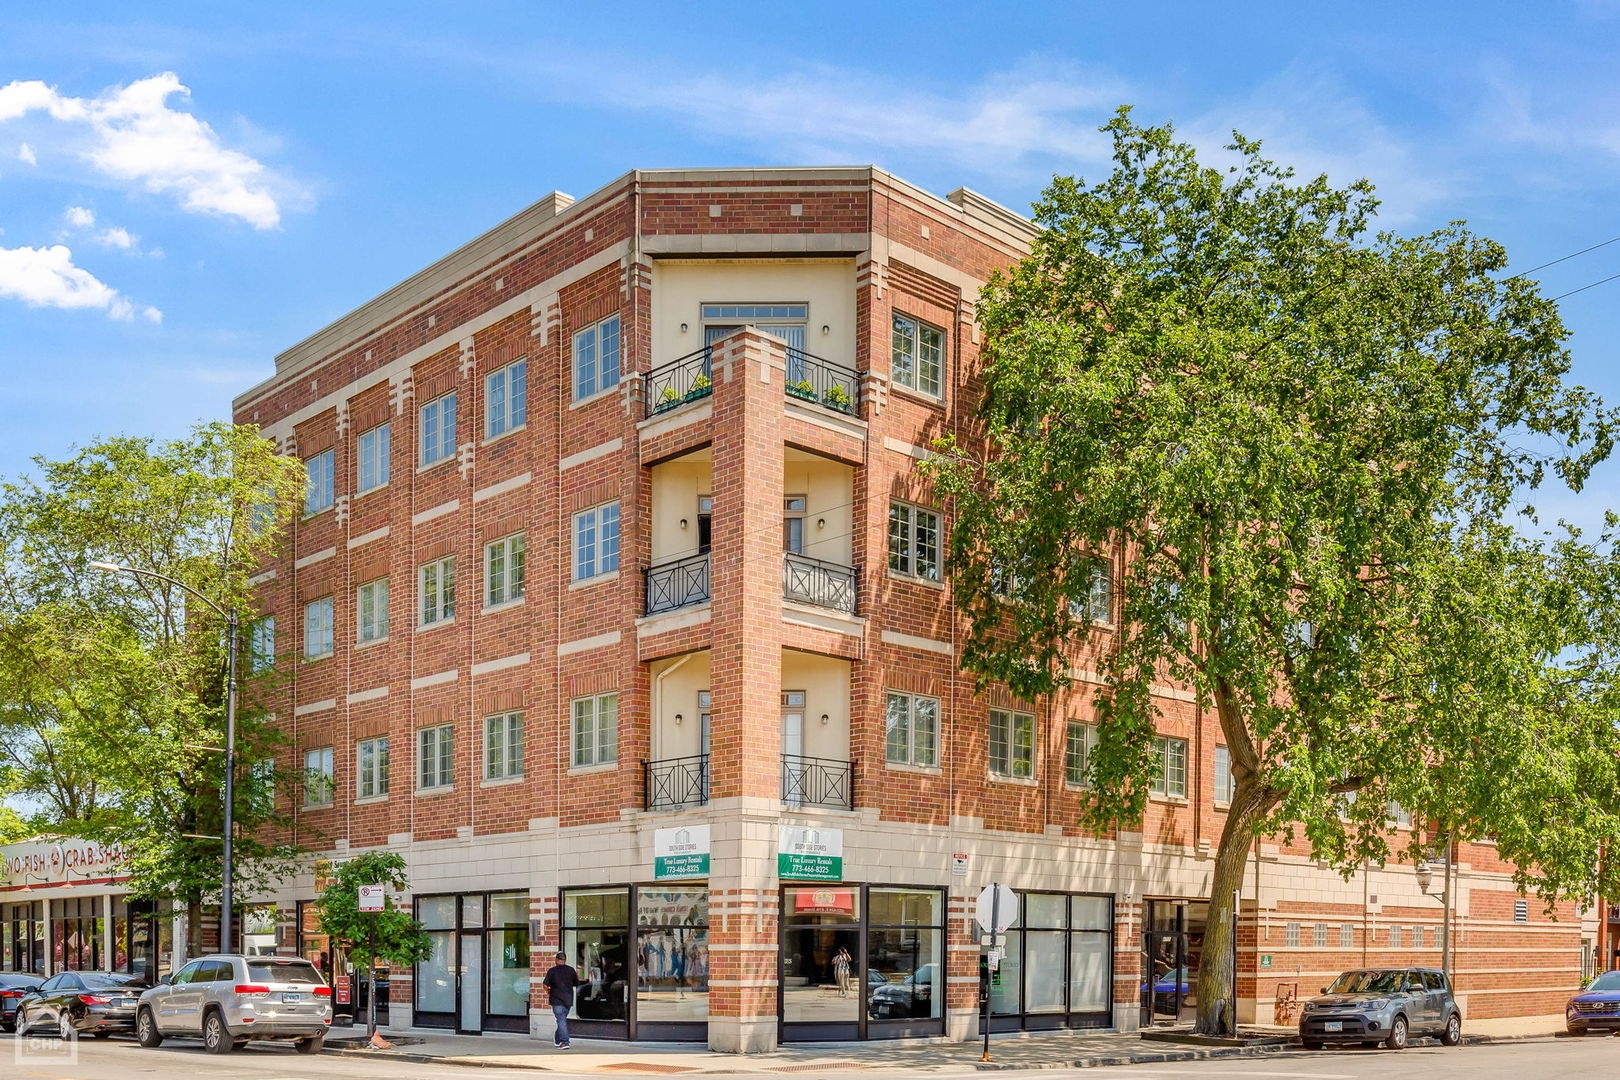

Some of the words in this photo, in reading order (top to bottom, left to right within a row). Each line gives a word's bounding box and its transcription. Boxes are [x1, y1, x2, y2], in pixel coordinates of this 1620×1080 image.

[25, 854, 46, 872] FISH
[66, 847, 93, 868] CRAB
[674, 857, 688, 866] Luxury
[688, 855, 703, 863] Rentals
[801, 856, 816, 865] Luxury
[817, 857, 833, 865] Rentals
[792, 864, 829, 873] 773-466-8325
